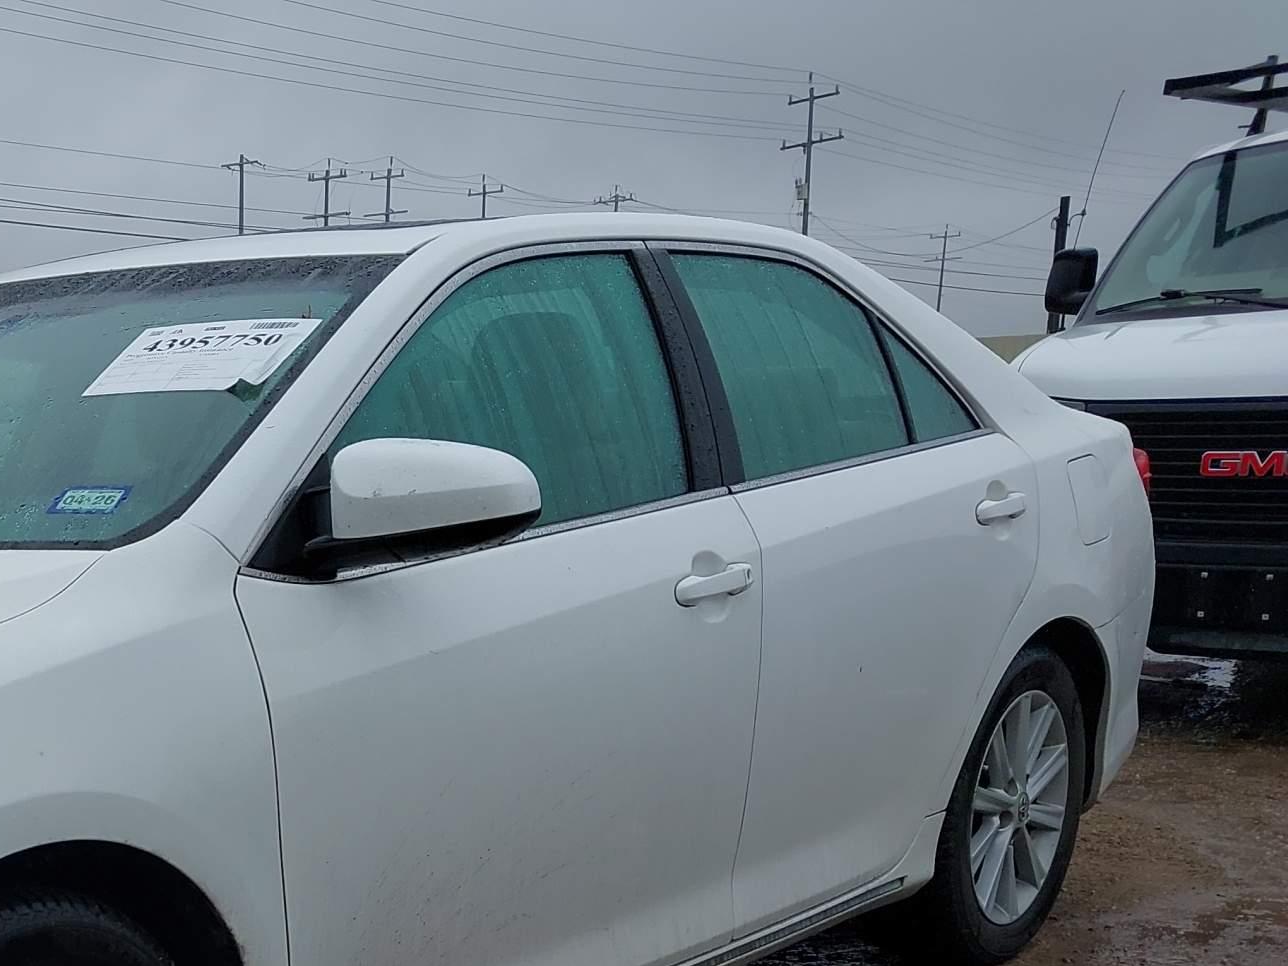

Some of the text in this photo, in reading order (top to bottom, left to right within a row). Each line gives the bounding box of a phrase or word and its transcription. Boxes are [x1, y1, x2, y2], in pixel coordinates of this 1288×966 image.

[143, 333, 283, 352] 43957750
[1200, 450, 1288, 477] GM
[91, 494, 117, 506] 26
